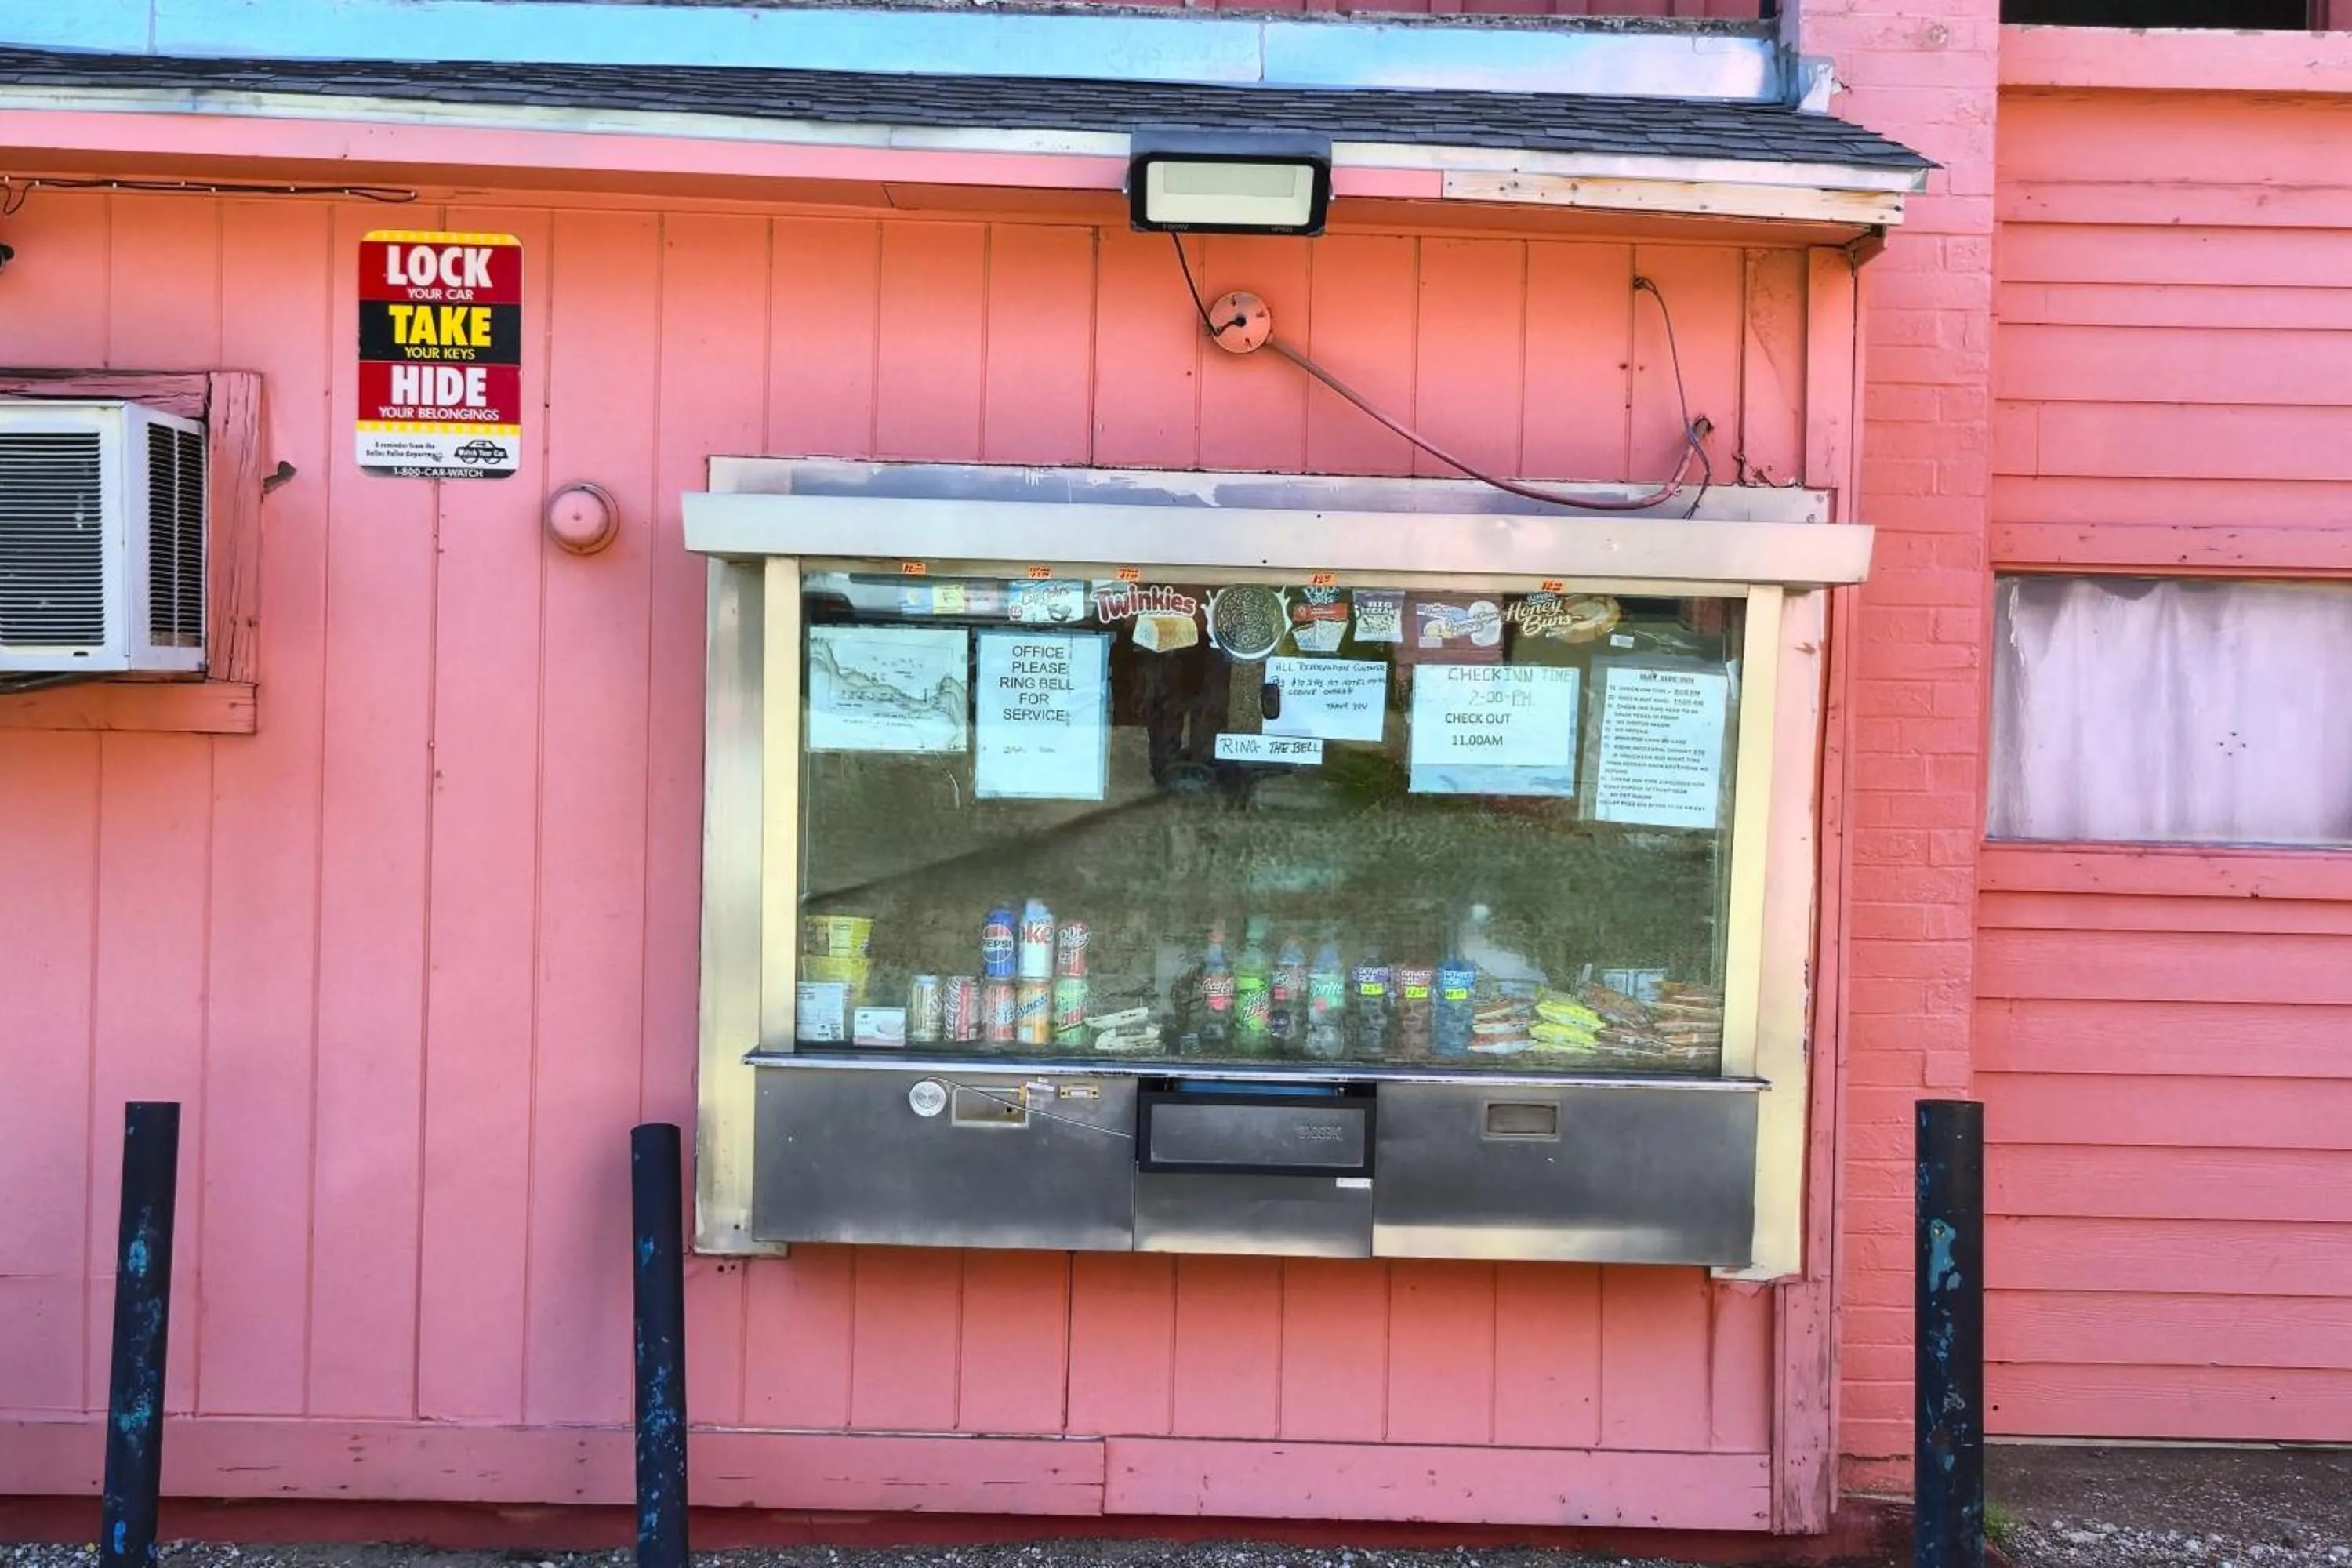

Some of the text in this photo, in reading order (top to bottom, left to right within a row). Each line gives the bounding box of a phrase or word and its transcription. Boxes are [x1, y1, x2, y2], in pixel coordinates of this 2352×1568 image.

[387, 245, 493, 288] LOCK
[407, 288, 474, 301] YOUR CAR
[389, 305, 492, 347] TAKE
[405, 347, 476, 360] YOUR KEYS
[392, 365, 487, 407] HIDE
[379, 406, 499, 421] YOUR BELONGINGS
[1089, 584, 1196, 624] Twinkies
[1506, 598, 1564, 621] Honey
[1521, 615, 1573, 637] Buns
[1012, 645, 1065, 659] OFFICE
[1012, 661, 1067, 675] PLEASE
[1542, 669, 1573, 682] TIME
[1000, 677, 1074, 691] RING BELL
[1019, 692, 1049, 705] FOR
[1003, 708, 1065, 722] SERVICE
[1445, 713, 1512, 724] CHECK OUT
[1220, 738, 1322, 754] RING THE BELL
[1452, 735, 1503, 746] 11.00AM
[1310, 981, 1343, 996] Sprite
